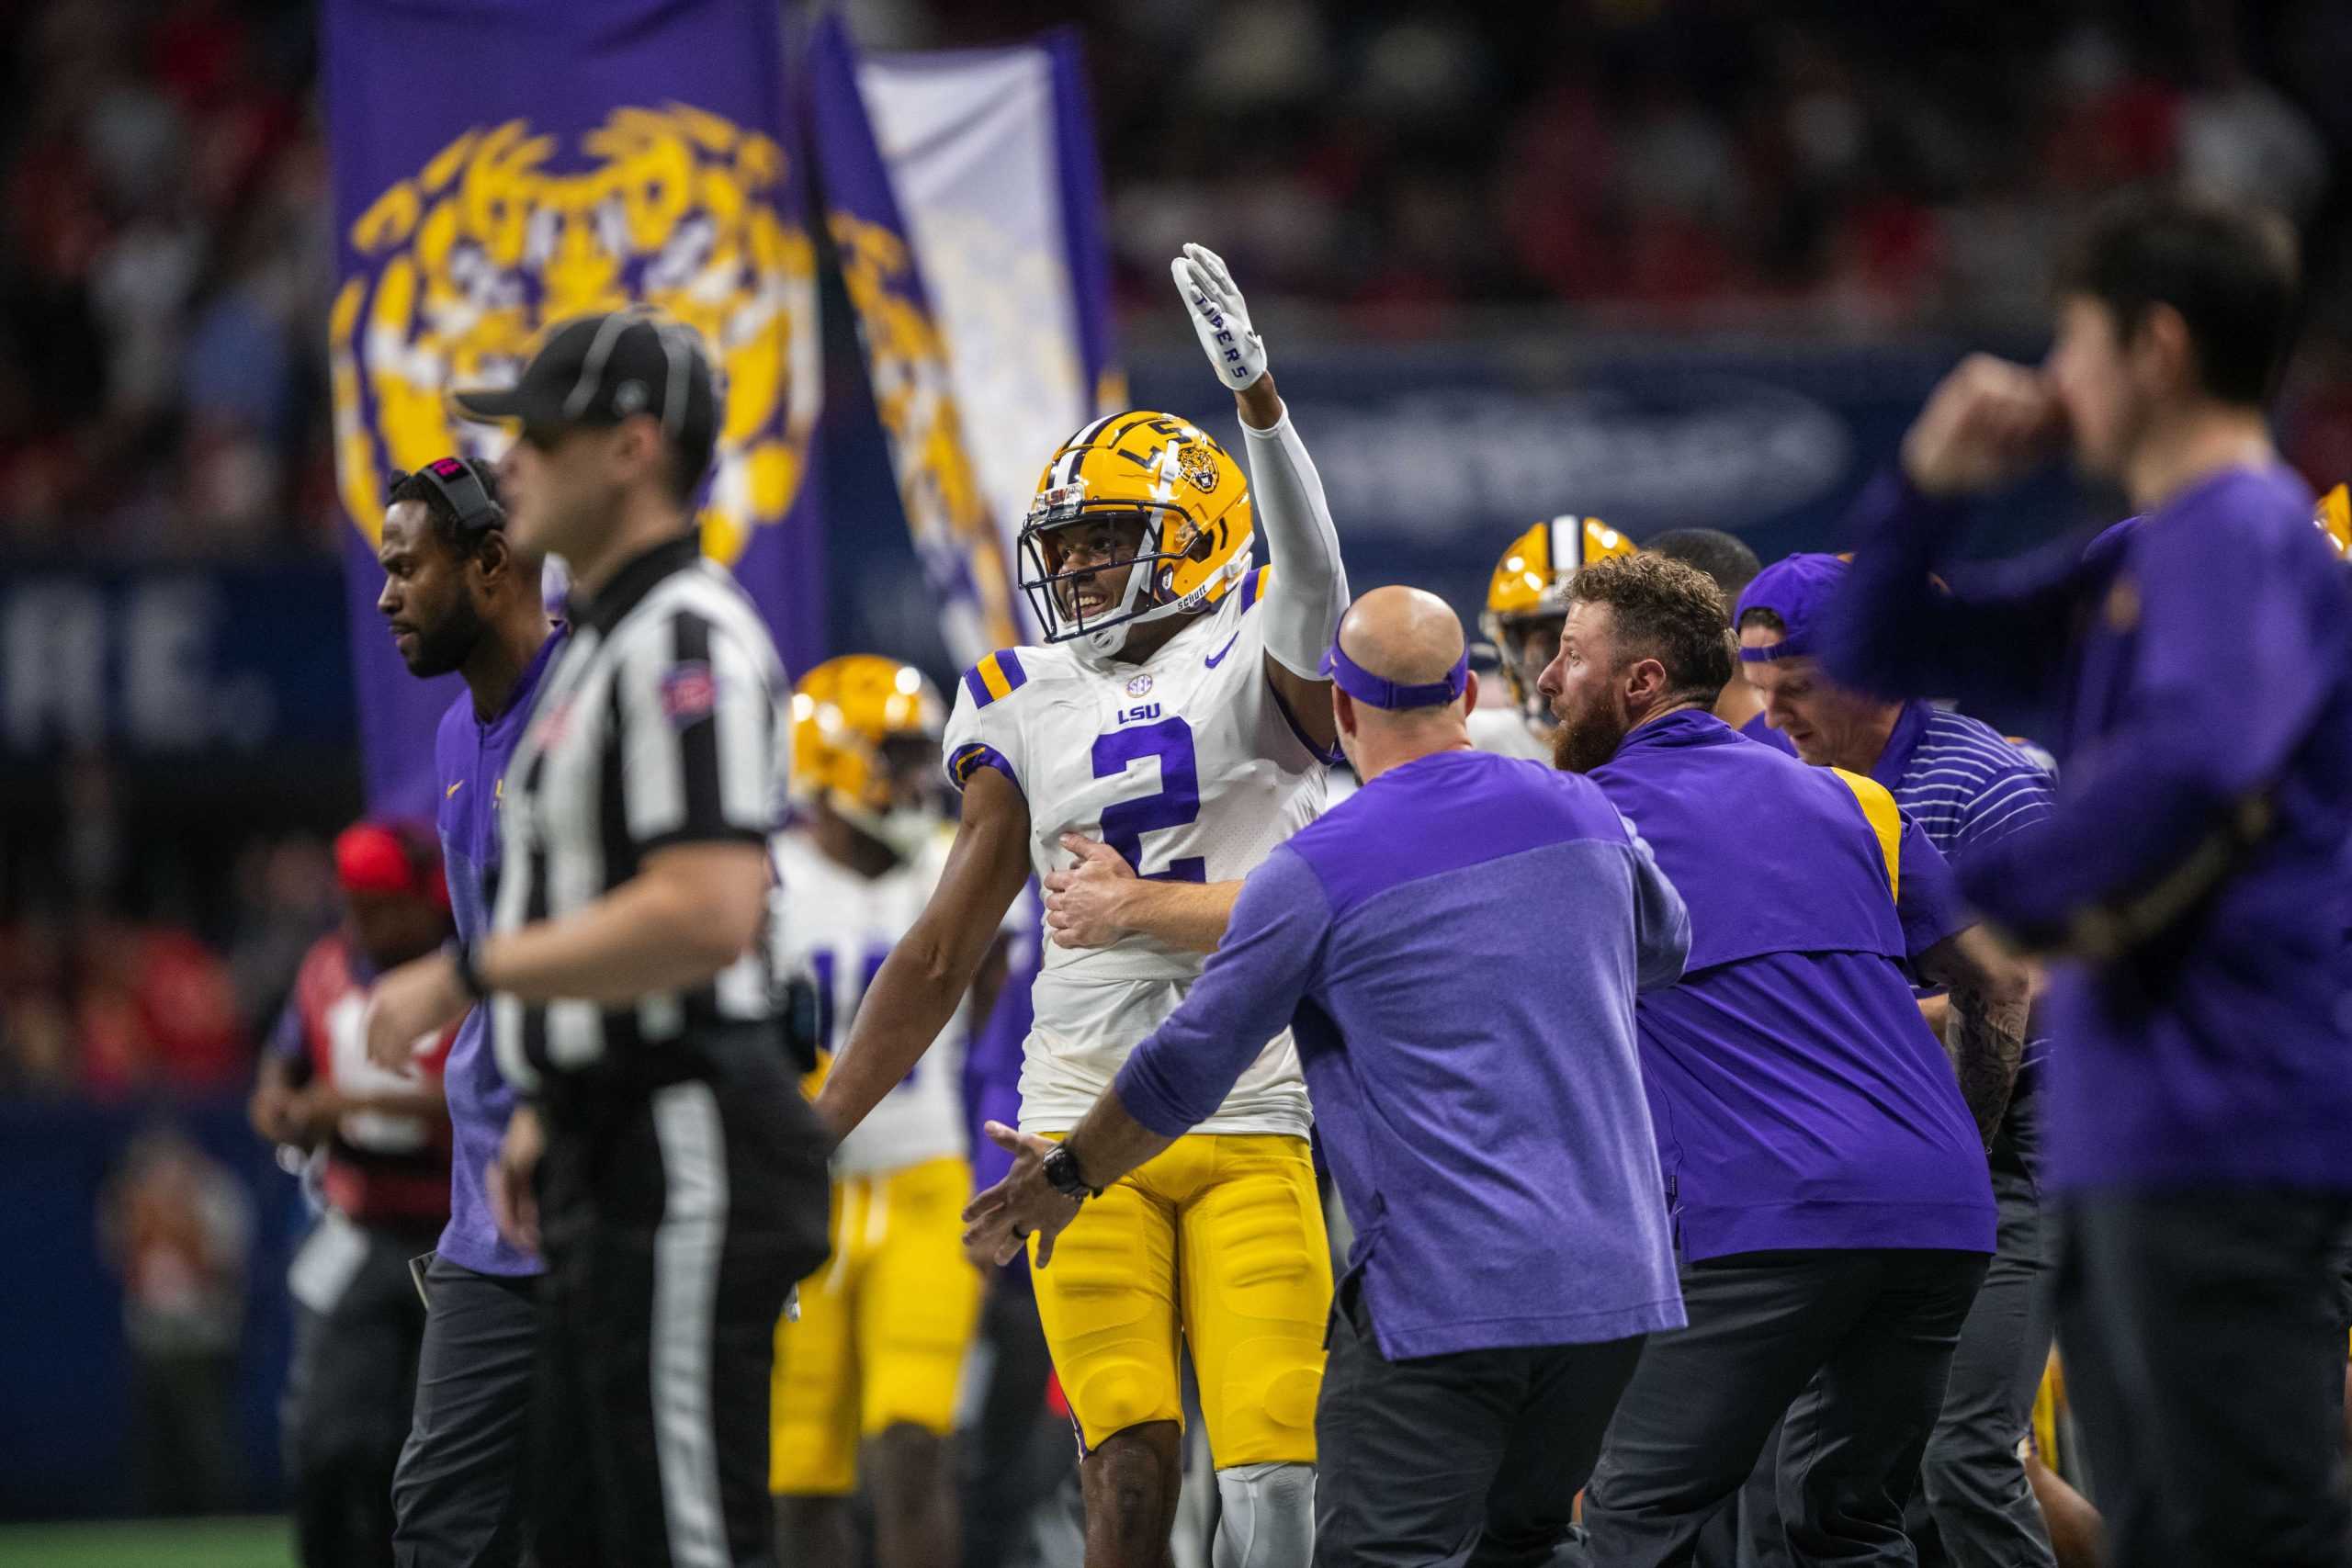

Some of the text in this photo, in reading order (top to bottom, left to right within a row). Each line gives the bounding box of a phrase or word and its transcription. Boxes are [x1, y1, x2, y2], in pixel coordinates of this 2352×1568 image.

[1194, 291, 1248, 378] TIGERS
[1177, 583, 1207, 610] schutt
[1117, 702, 1161, 725] LSU
[1091, 716, 1206, 885] 2
